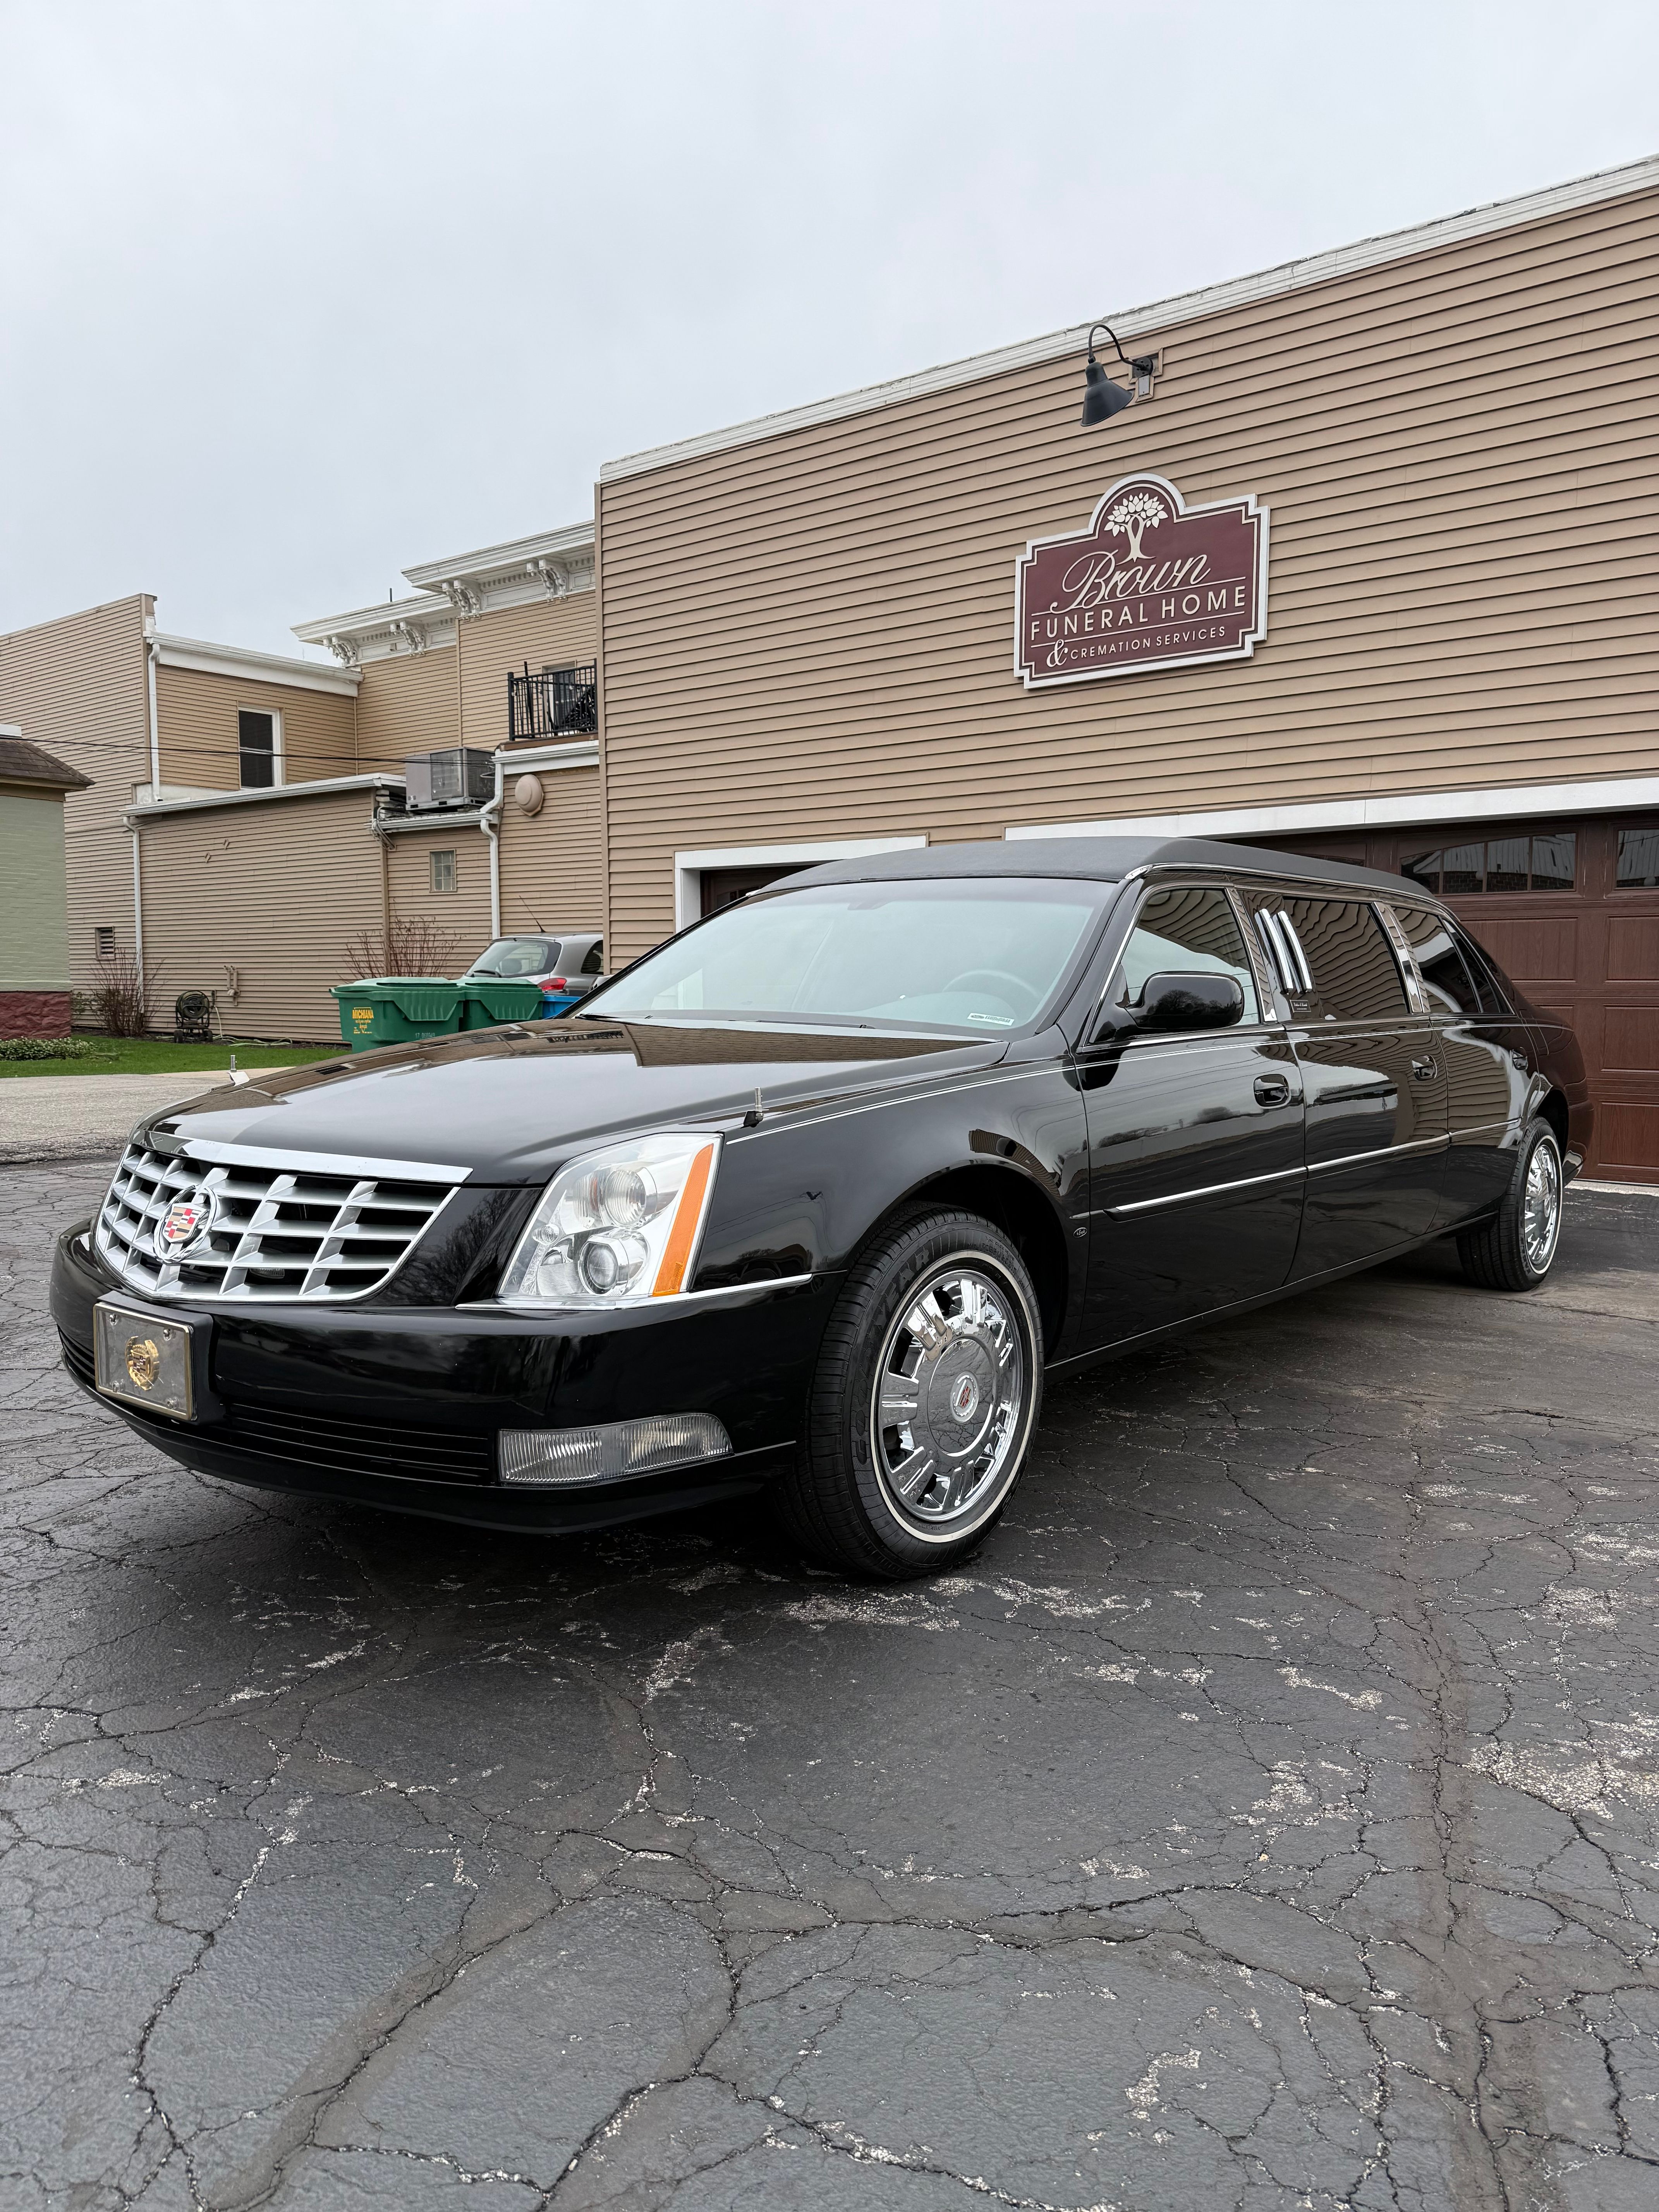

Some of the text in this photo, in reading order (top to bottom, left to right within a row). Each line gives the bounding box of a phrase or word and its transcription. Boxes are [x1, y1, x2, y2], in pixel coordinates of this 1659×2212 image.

[1050, 550, 1211, 614] Brown
[1031, 586, 1246, 641] FUNERAL HOME
[1046, 626, 1225, 668] & CREMATION SERVICES
[352, 1010, 374, 1019] MICHIANA
